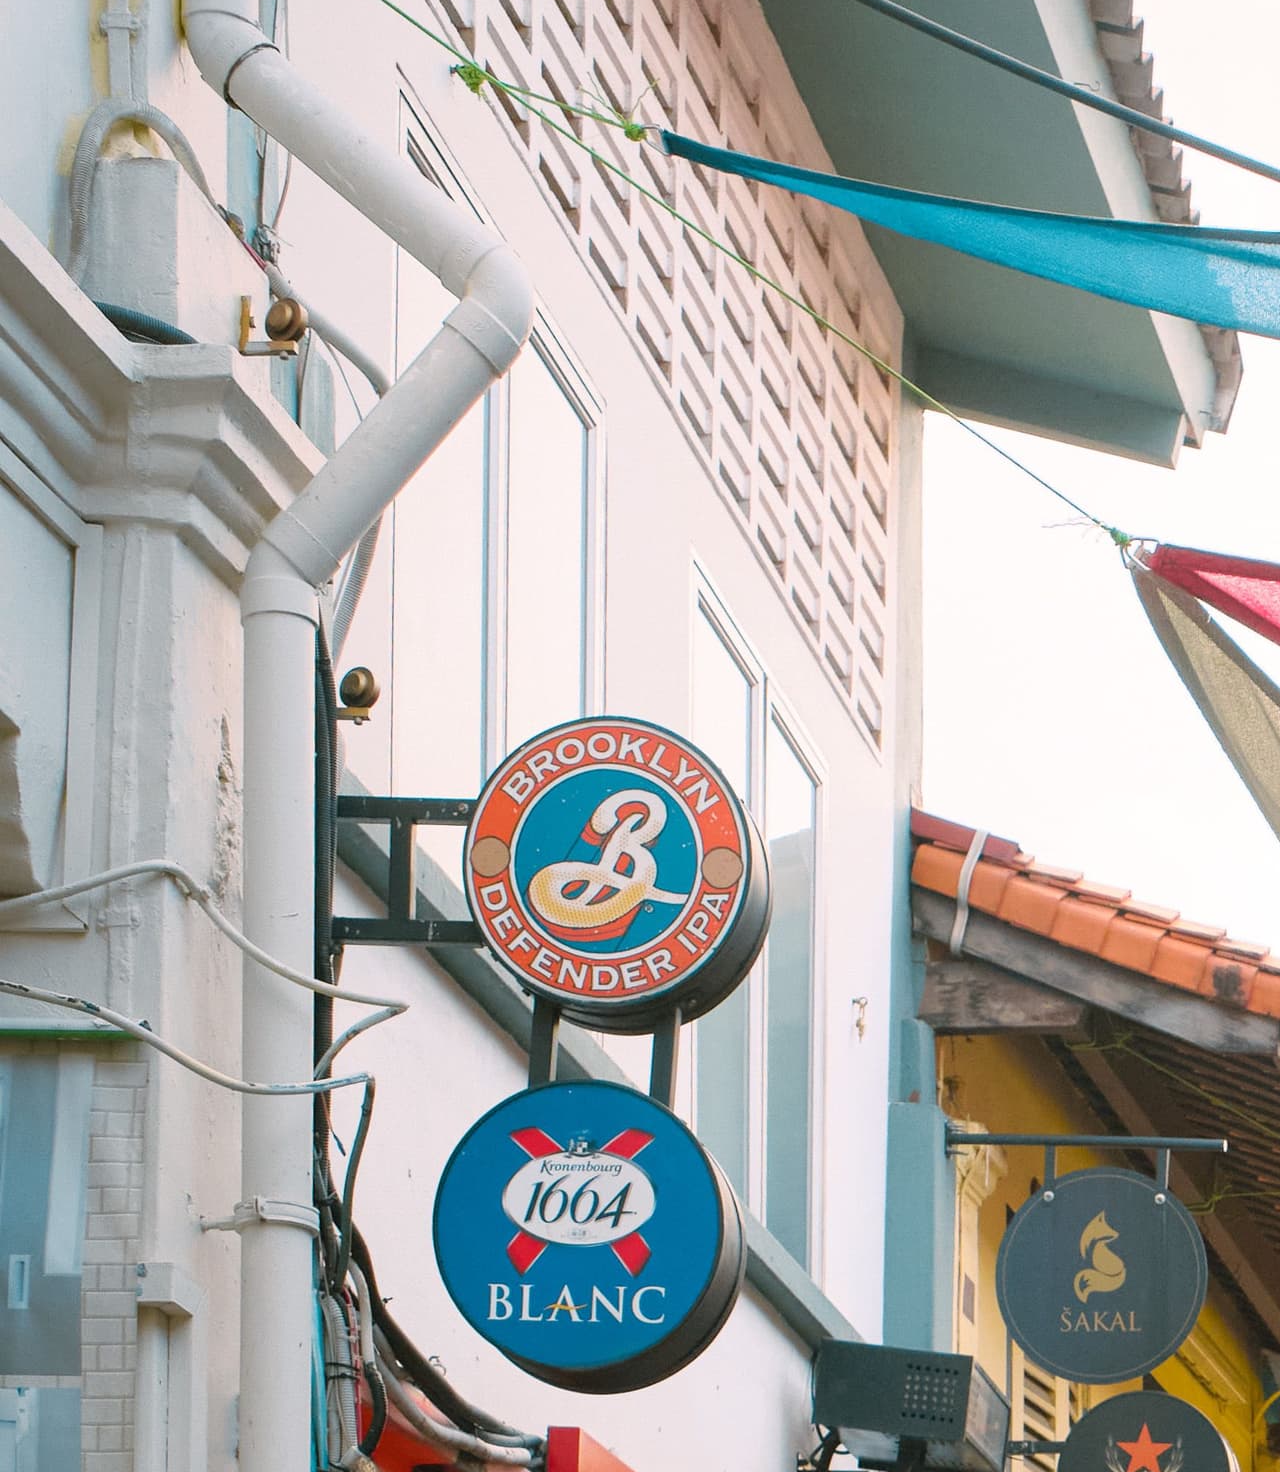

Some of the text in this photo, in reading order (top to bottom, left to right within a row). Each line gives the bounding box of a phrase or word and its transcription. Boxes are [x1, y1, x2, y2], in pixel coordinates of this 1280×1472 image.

[501, 731, 719, 818] BROOKLYN
[476, 880, 731, 994] DEFENDER IPA
[540, 1160, 622, 1176] Kronenbourg
[523, 1174, 637, 1228] 1664
[487, 1284, 667, 1325] BLANC
